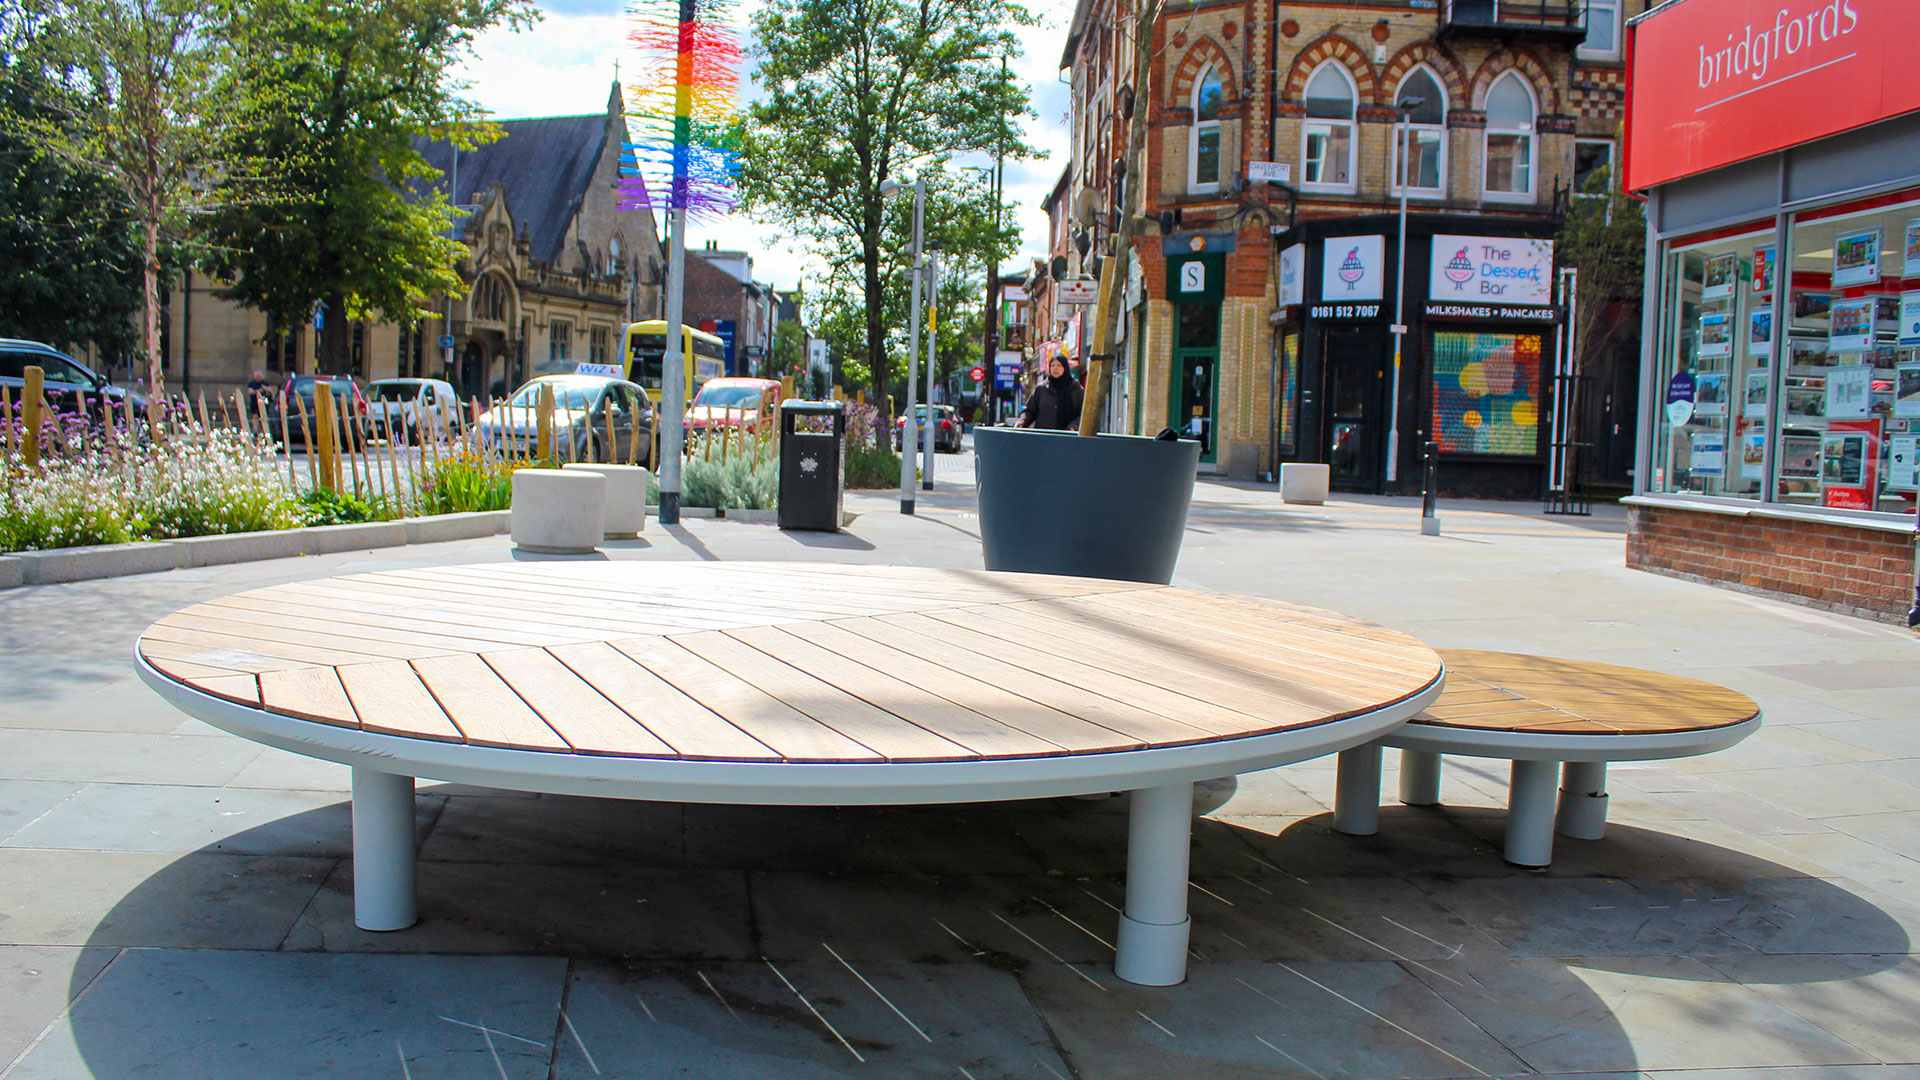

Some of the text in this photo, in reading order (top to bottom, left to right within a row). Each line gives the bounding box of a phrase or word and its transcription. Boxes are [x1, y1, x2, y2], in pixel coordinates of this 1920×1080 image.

[1698, 0, 1858, 88] bridgfords
[1250, 163, 1289, 172] DAVENPORT
[1263, 169, 1276, 177] AVE
[1481, 245, 1511, 261] The
[1187, 266, 1198, 287] S
[1481, 263, 1541, 281] Dessert
[1480, 281, 1508, 295] Bar
[1311, 305, 1380, 318] 0161 512 7067
[1426, 305, 1554, 319] MILKSHAKES PANCAKES
